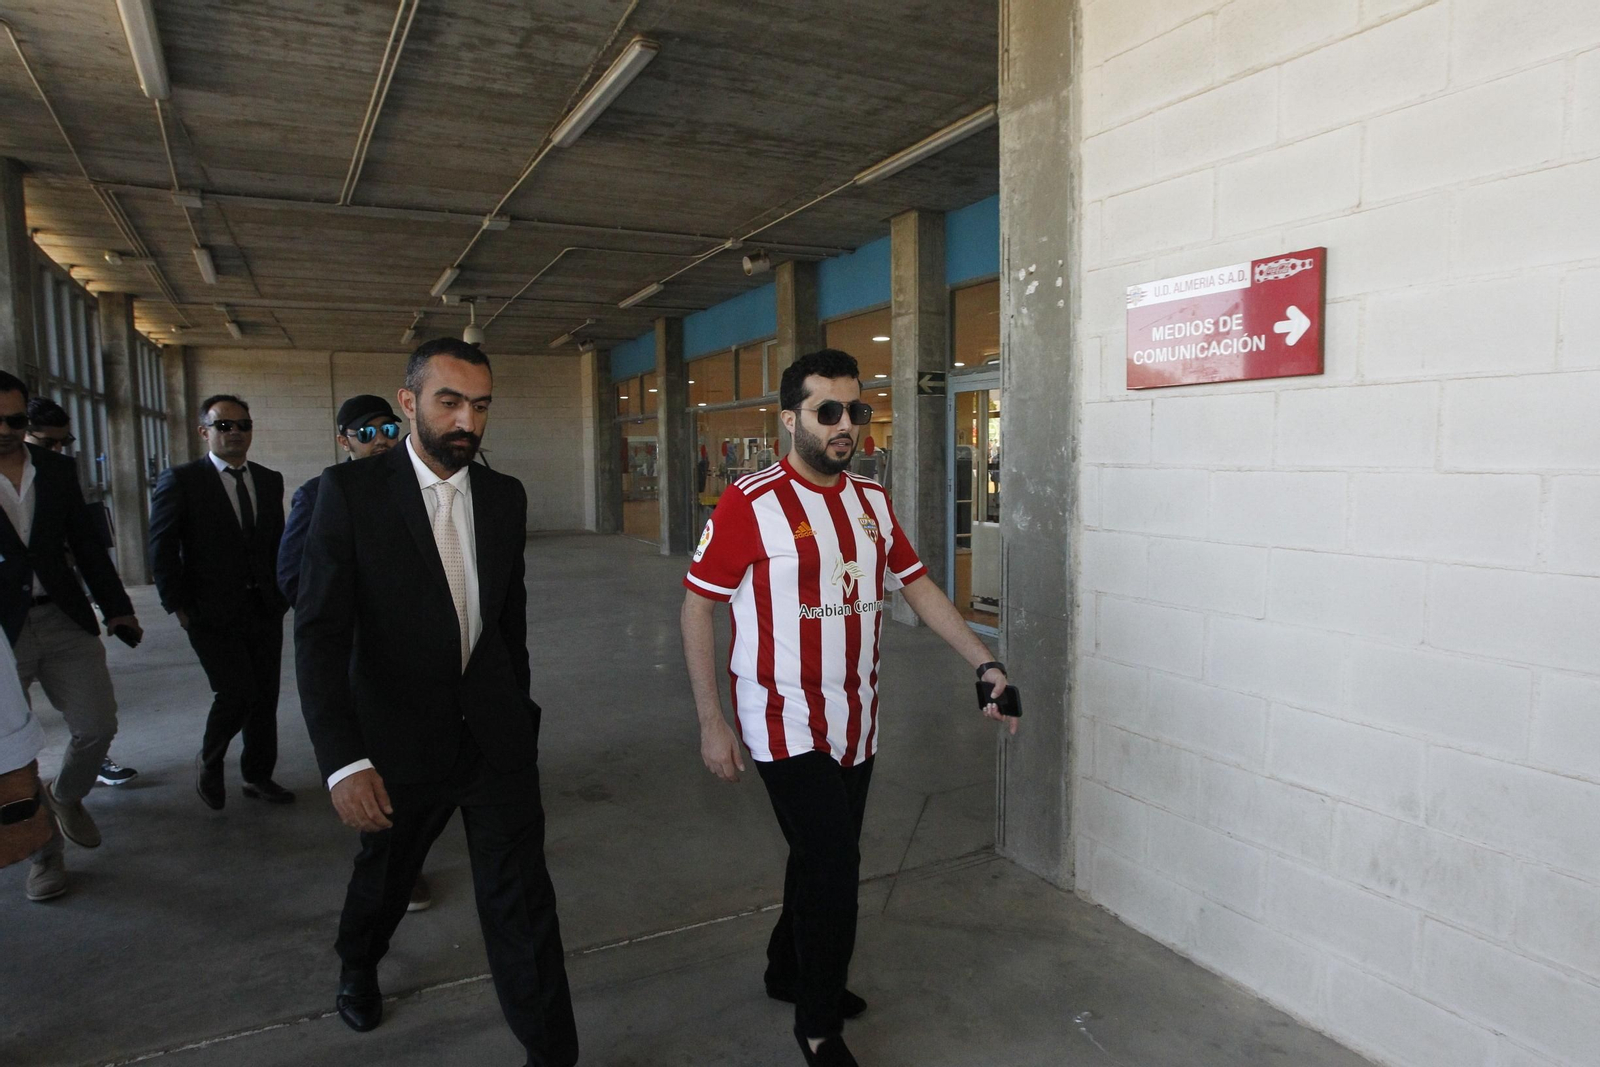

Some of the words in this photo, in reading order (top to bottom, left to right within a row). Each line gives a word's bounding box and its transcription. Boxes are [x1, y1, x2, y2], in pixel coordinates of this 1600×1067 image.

[1154, 285, 1171, 297] U.D.
[1173, 275, 1216, 293] ALMERIA
[1217, 269, 1248, 286] S.A.D.
[1152, 318, 1214, 341] MEDIOS
[1218, 314, 1244, 331] DE
[1133, 333, 1265, 364] COMUNICACIÓN
[799, 603, 851, 618] Arabian
